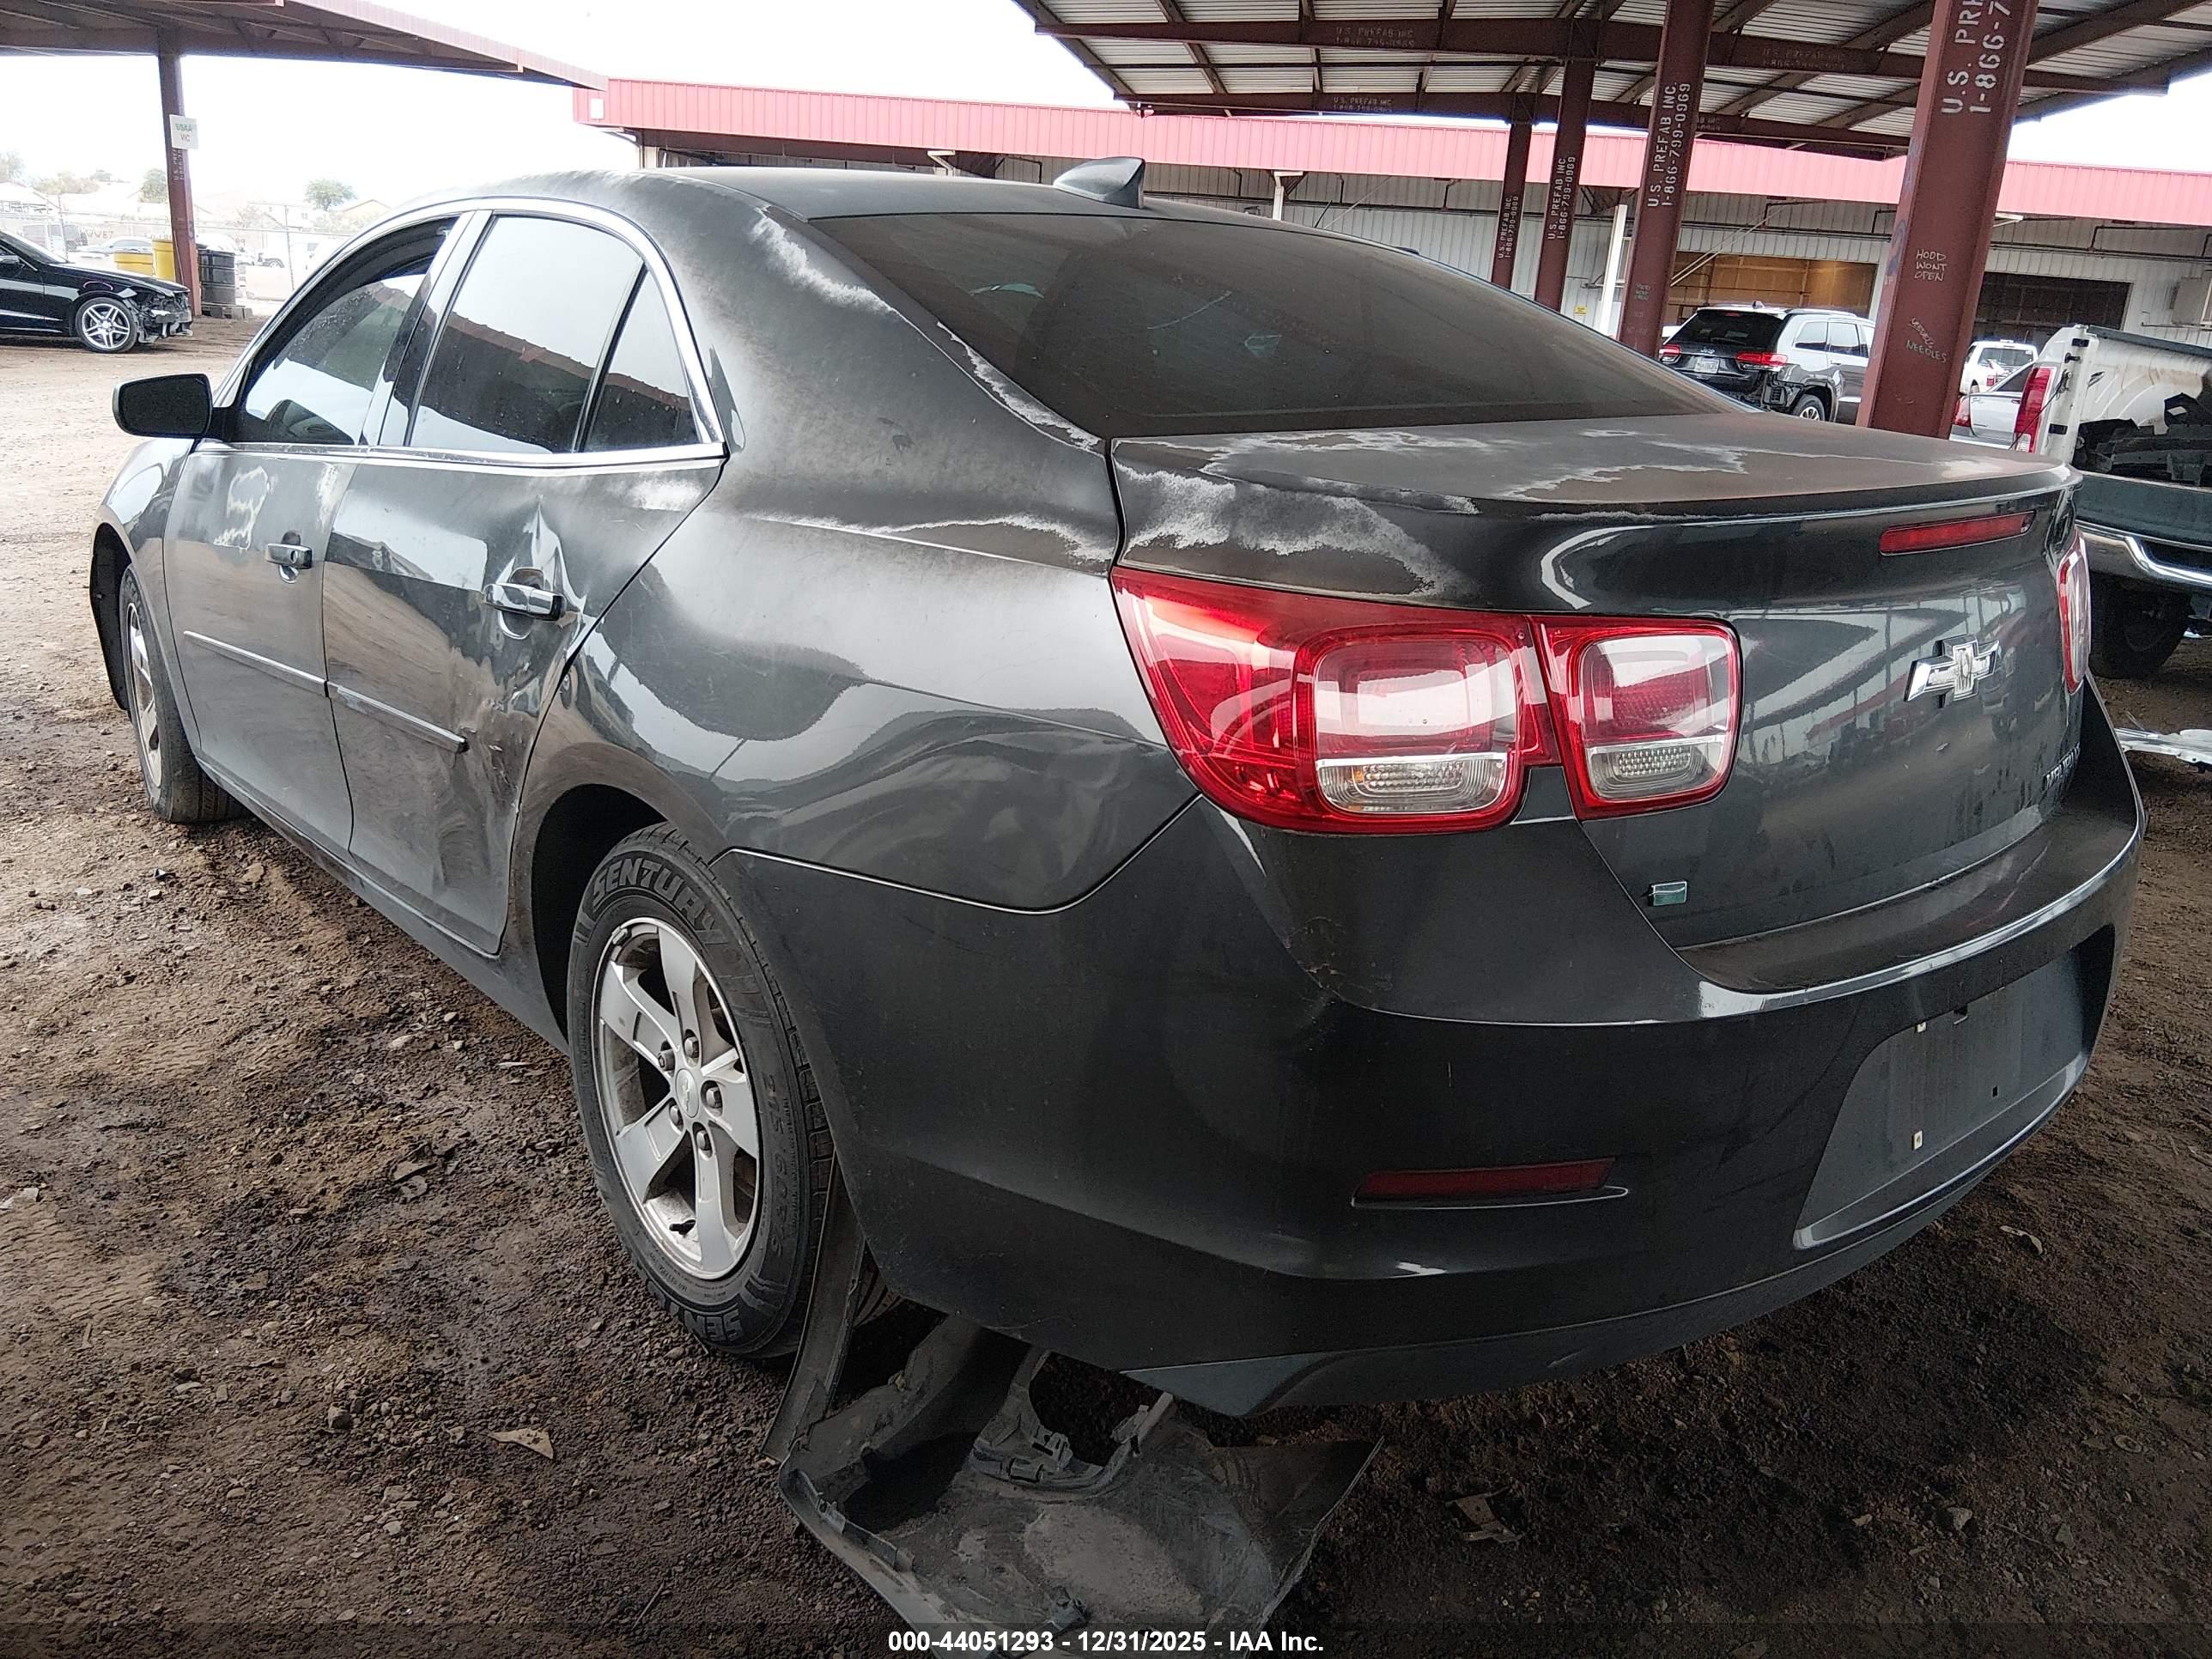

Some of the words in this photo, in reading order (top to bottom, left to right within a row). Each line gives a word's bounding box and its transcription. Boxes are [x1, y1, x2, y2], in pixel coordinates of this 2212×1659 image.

[1941, 63, 1972, 112] U.S.
[1653, 116, 1672, 173] PREFAB
[1662, 82, 1691, 207] 1-866-799-0969
[1551, 178, 1564, 216] PREFAB
[1647, 179, 1662, 208] U.S.
[1914, 270, 1944, 282] OPEN
[1916, 261, 1948, 271] WONT
[1906, 338, 1948, 363] NEEDLES
[592, 857, 730, 945] SENTURY
